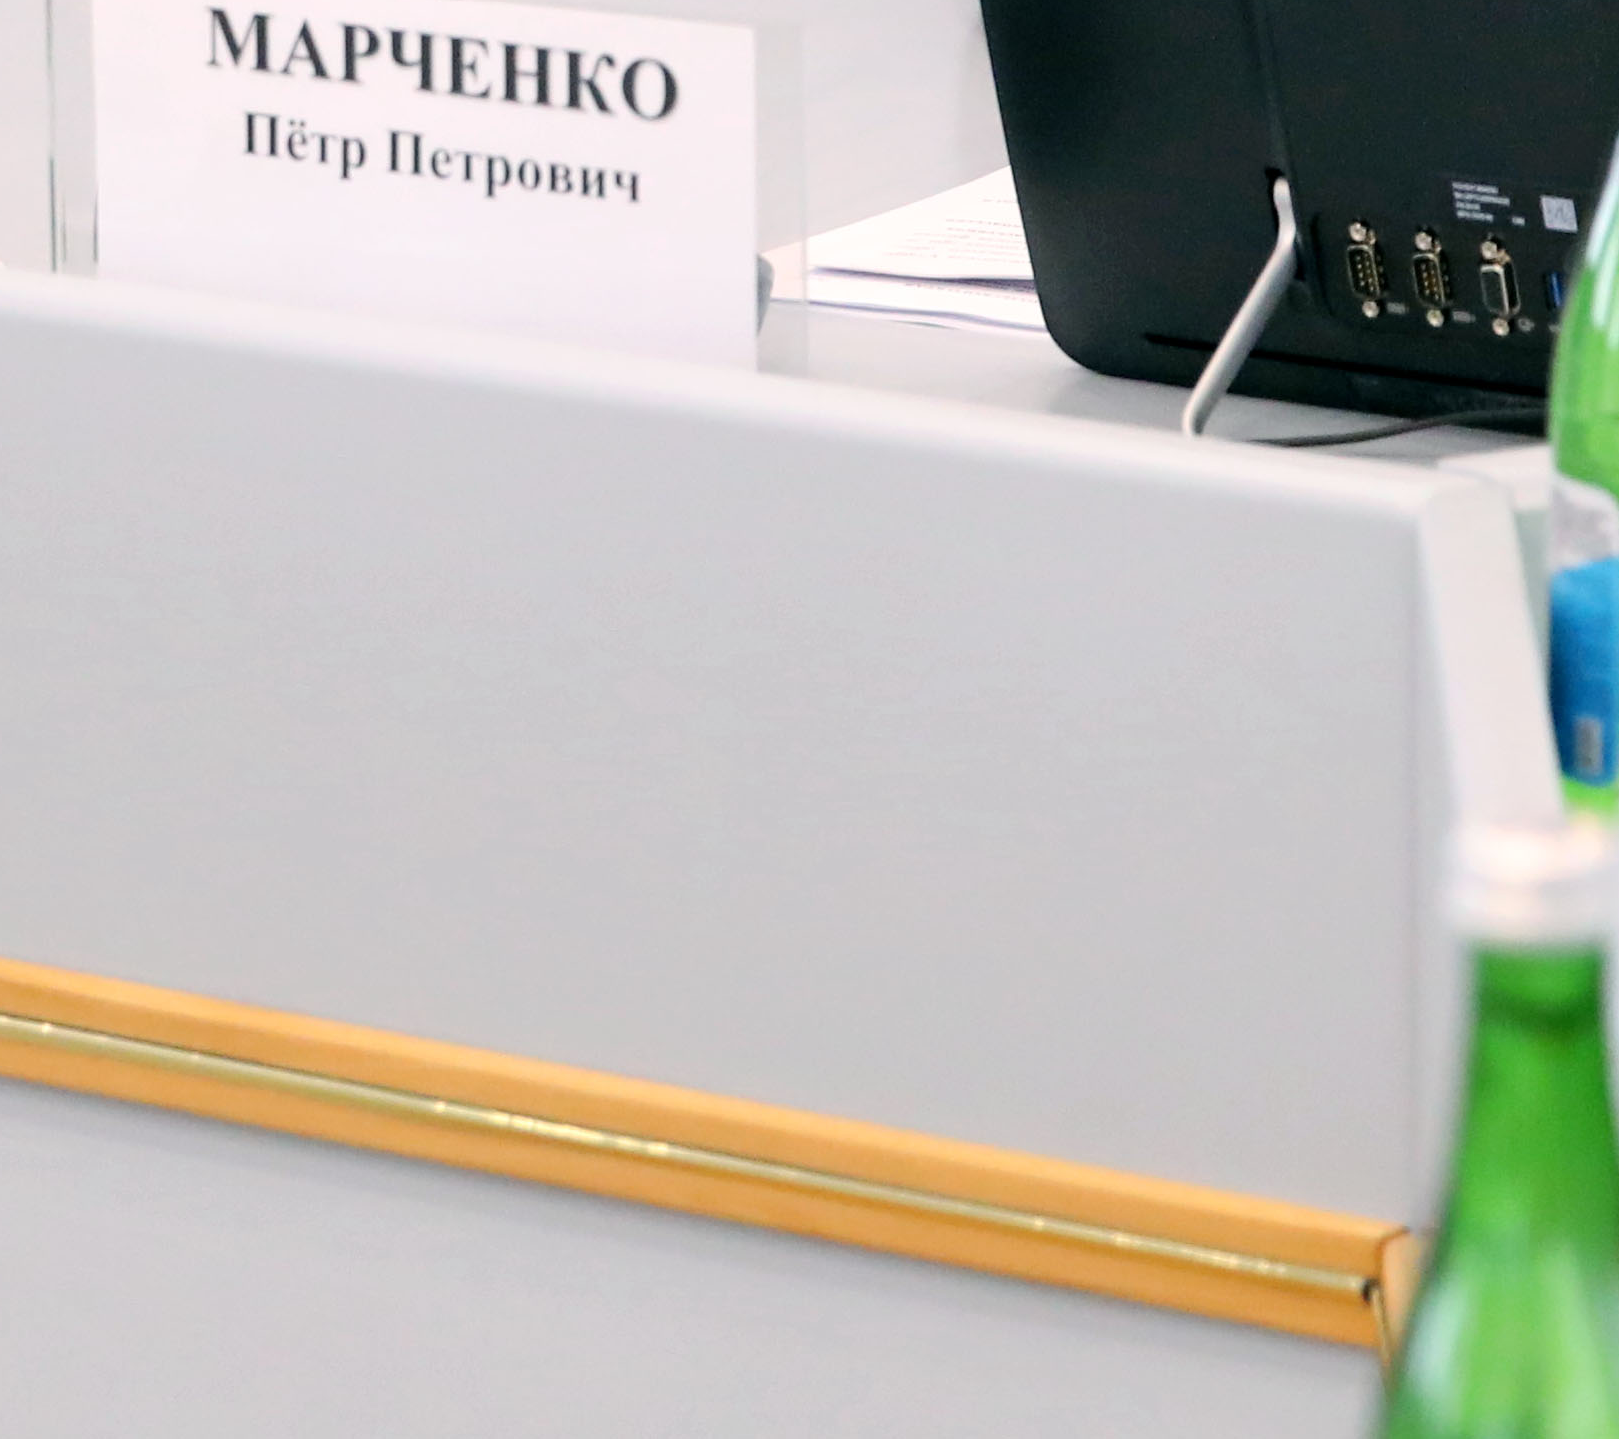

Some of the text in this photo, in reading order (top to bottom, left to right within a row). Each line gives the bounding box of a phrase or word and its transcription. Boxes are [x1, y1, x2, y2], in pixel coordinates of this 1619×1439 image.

[207, 7, 680, 123] МАРЧЕНКО
[244, 111, 641, 204] Пётр Петрович
